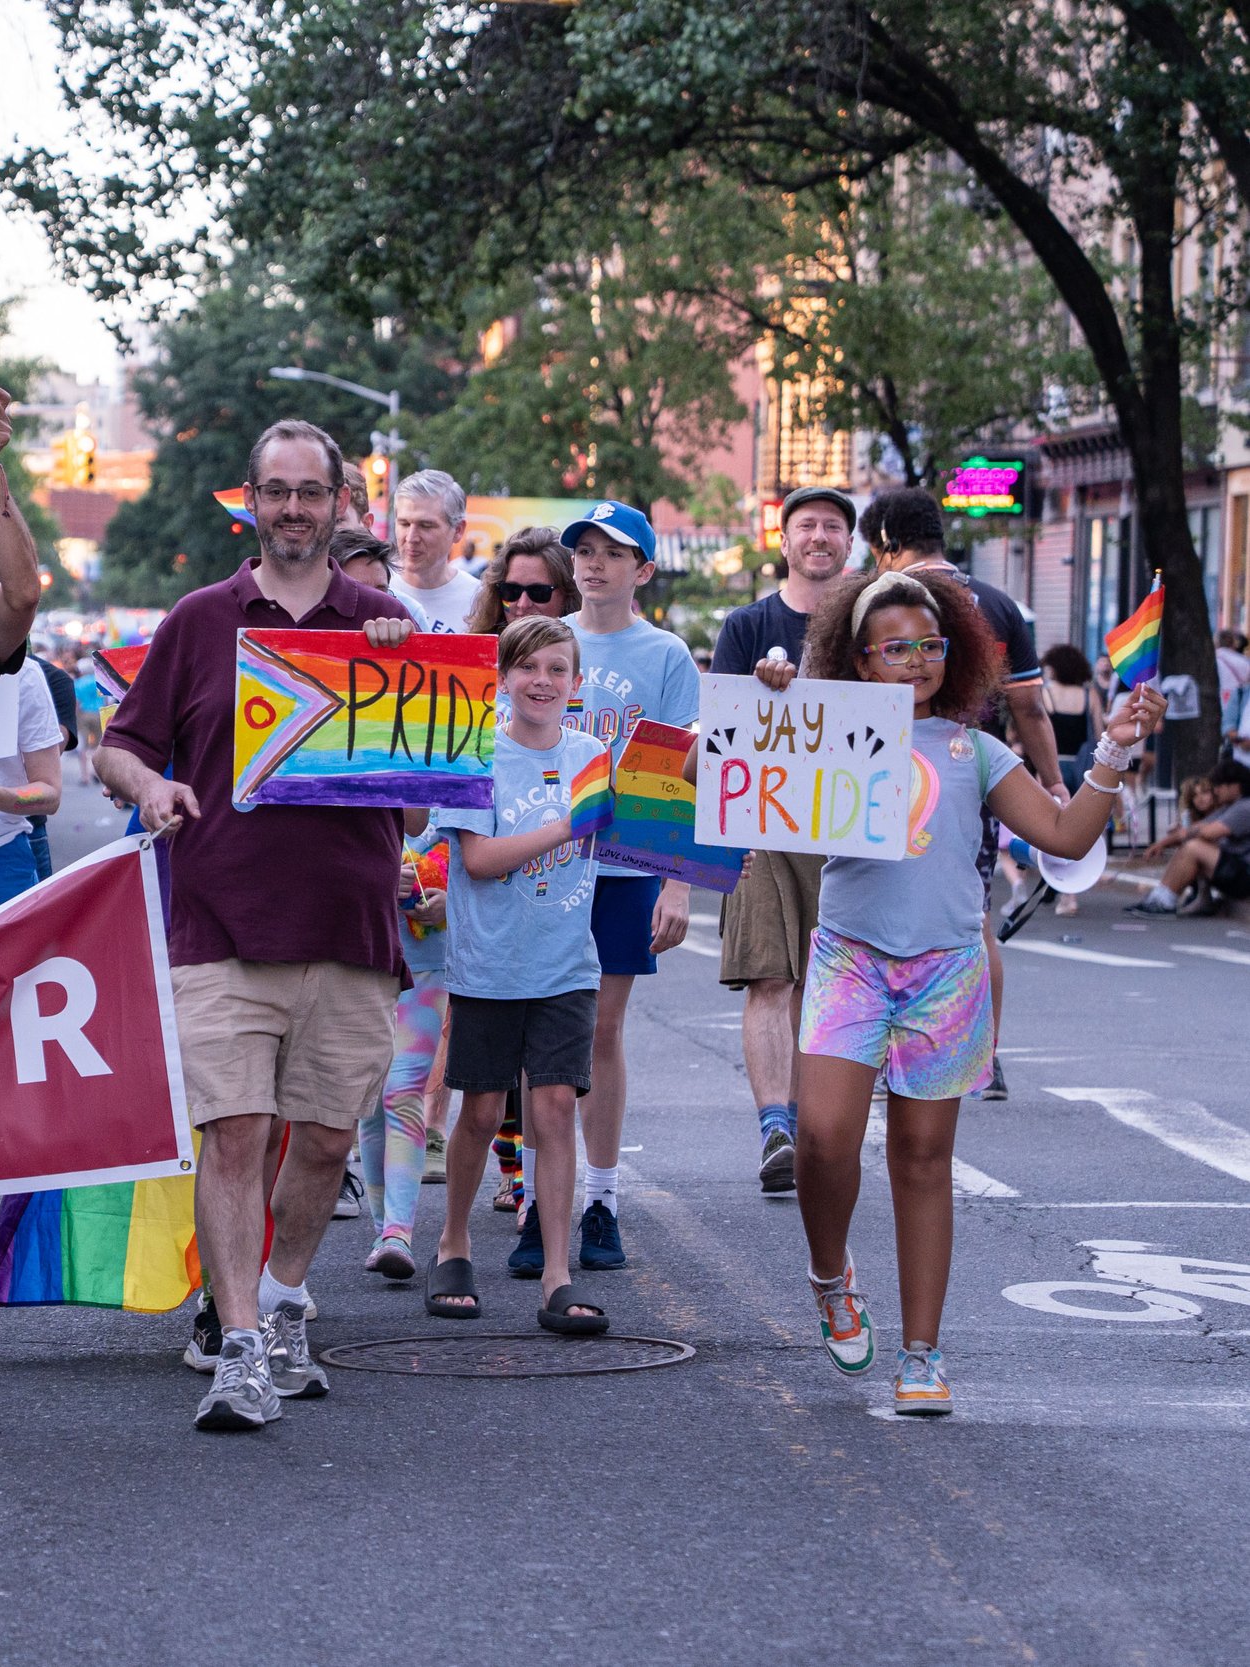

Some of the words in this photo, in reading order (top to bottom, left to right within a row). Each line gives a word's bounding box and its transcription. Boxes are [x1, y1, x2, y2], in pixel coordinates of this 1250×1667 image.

[753, 699, 825, 754] YAY
[502, 784, 572, 826] PACKE
[718, 757, 892, 845] PRIDE
[560, 879, 593, 913] 2023
